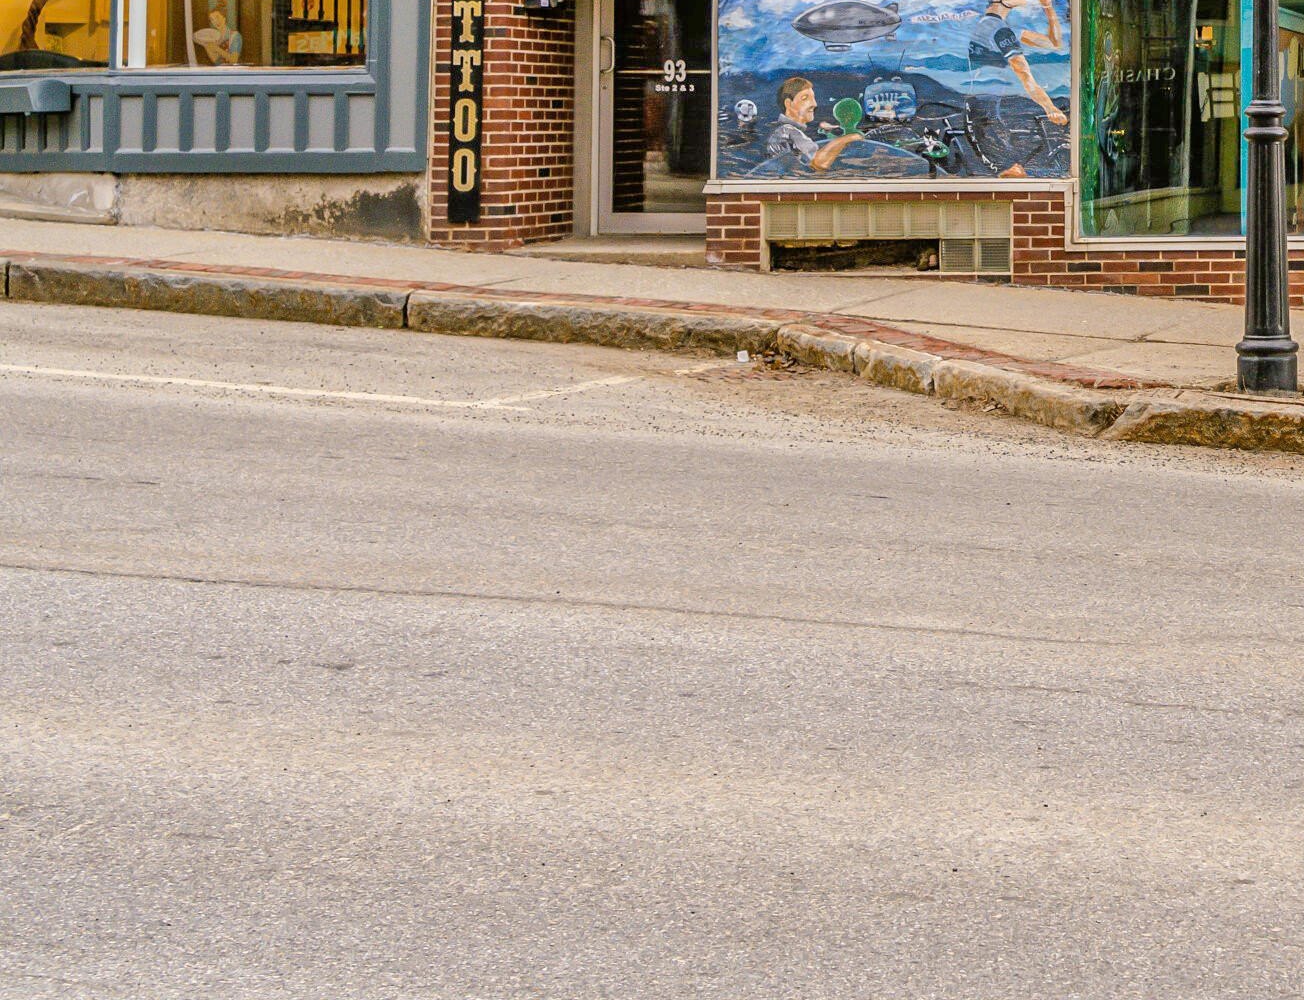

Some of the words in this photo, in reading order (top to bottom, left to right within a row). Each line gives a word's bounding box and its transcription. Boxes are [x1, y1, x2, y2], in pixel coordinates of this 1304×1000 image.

[664, 59, 687, 82] 93
[655, 84, 671, 92] Ste
[672, 84, 678, 92] 2
[680, 84, 687, 92] &
[689, 84, 695, 92] 3
